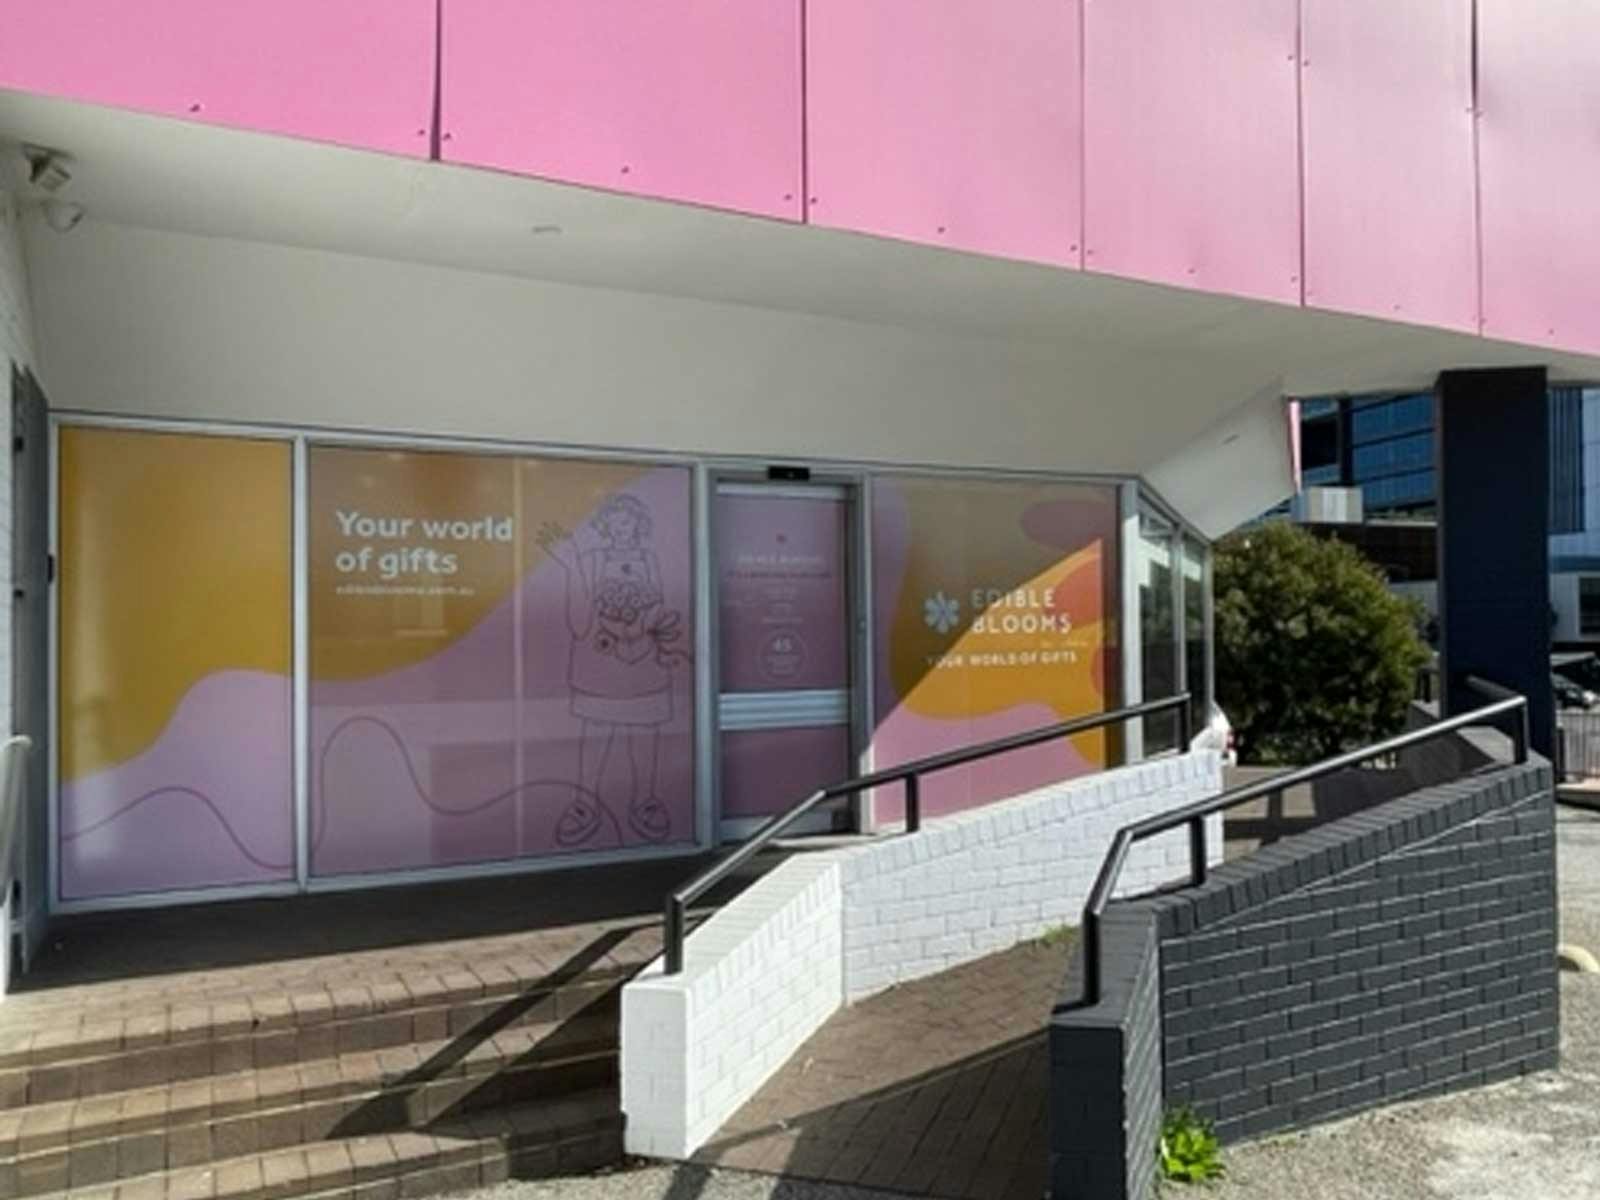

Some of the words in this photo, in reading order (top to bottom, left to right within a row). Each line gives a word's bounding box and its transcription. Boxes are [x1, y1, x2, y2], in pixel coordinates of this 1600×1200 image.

[336, 511, 413, 538] Your
[422, 517, 513, 541] world
[336, 547, 372, 573] of
[378, 547, 458, 580] gifts
[971, 587, 1056, 609] EDIBLE
[972, 611, 1072, 633] BLOOMS
[970, 653, 1016, 667] WORLD
[1018, 653, 1038, 666] OF
[1040, 650, 1078, 664] GIFTS
